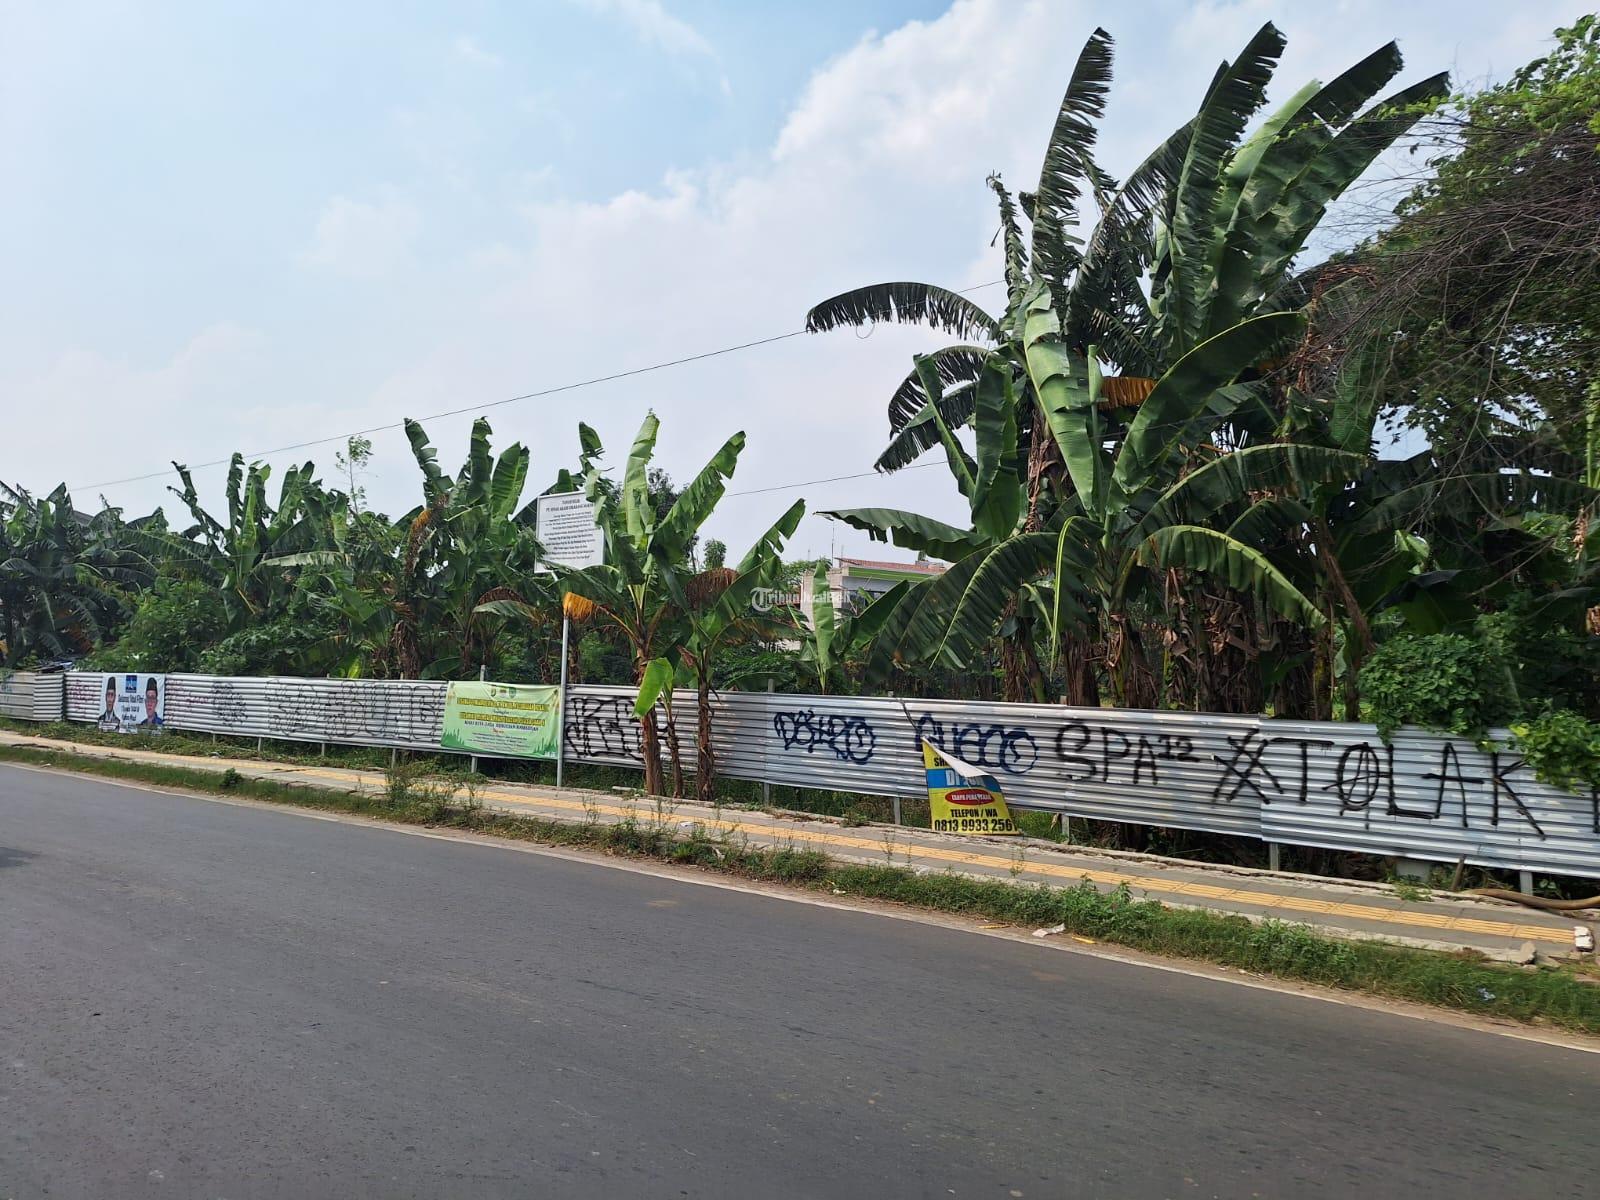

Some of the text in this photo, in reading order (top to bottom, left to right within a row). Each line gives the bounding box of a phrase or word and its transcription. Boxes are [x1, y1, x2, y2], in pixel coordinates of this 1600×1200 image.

[950, 808, 980, 818] TELEPON
[985, 808, 998, 818] WA
[934, 819, 959, 832] 0813
[961, 819, 989, 832] 9933
